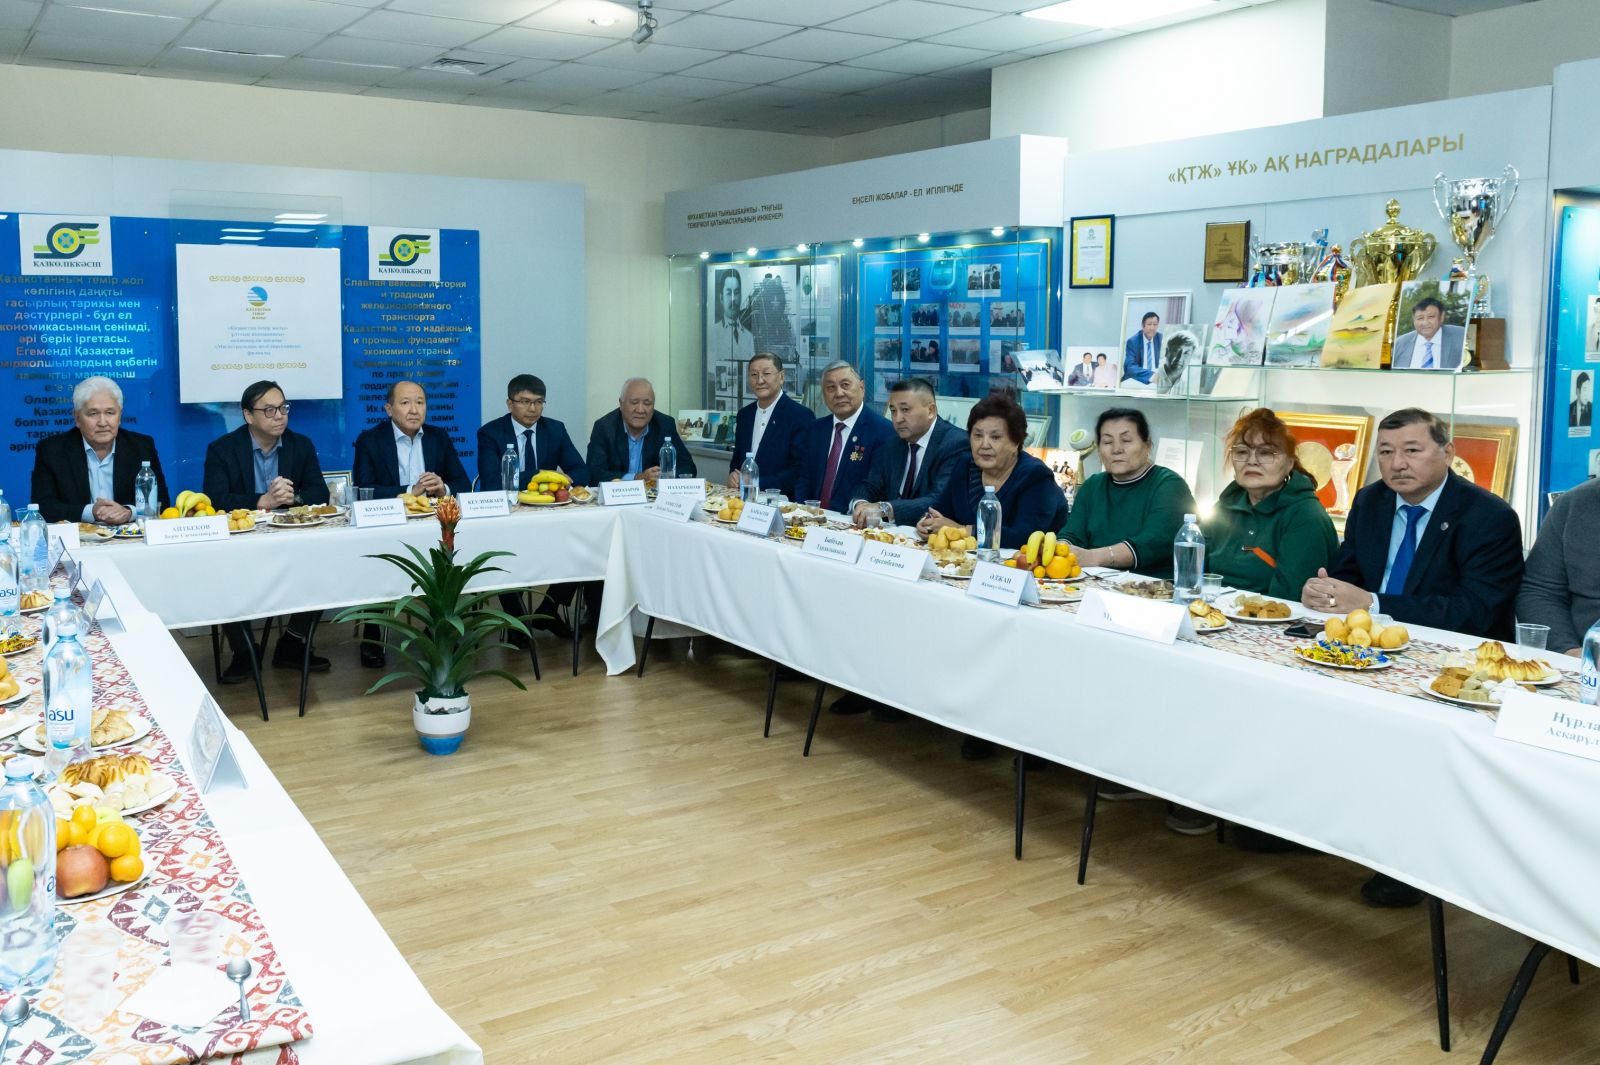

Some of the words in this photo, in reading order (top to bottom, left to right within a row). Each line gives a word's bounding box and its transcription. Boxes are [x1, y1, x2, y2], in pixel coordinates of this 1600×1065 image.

[1168, 163, 1221, 184] «ҚТЖ»
[1264, 155, 1289, 173] АҚ
[1295, 133, 1464, 169] НАГРАДАЛАРЫ
[876, 190, 908, 202] ЖОБАЛАР
[913, 188, 923, 197] ЕЛ
[344, 278, 386, 287] Славная
[429, 281, 467, 289] история
[24, 287, 76, 297] көлігінің
[79, 289, 122, 297] даңқты
[390, 291, 435, 300] традиции
[71, 300, 114, 310] тарихы
[361, 303, 452, 312] железнодорожного
[93, 310, 115, 321] бұл
[381, 314, 436, 323] транспорта
[104, 322, 150, 332] сенімді,
[41, 333, 72, 345] берік
[76, 333, 130, 345] іргетасы.
[408, 336, 460, 346] фундамент
[16, 346, 71, 357] Егеменді
[75, 346, 134, 357] Қазақстан
[417, 348, 454, 357] страны.
[115, 357, 158, 367] еңбегін
[15, 418, 48, 427] болат
[48, 708, 74, 721] asu
